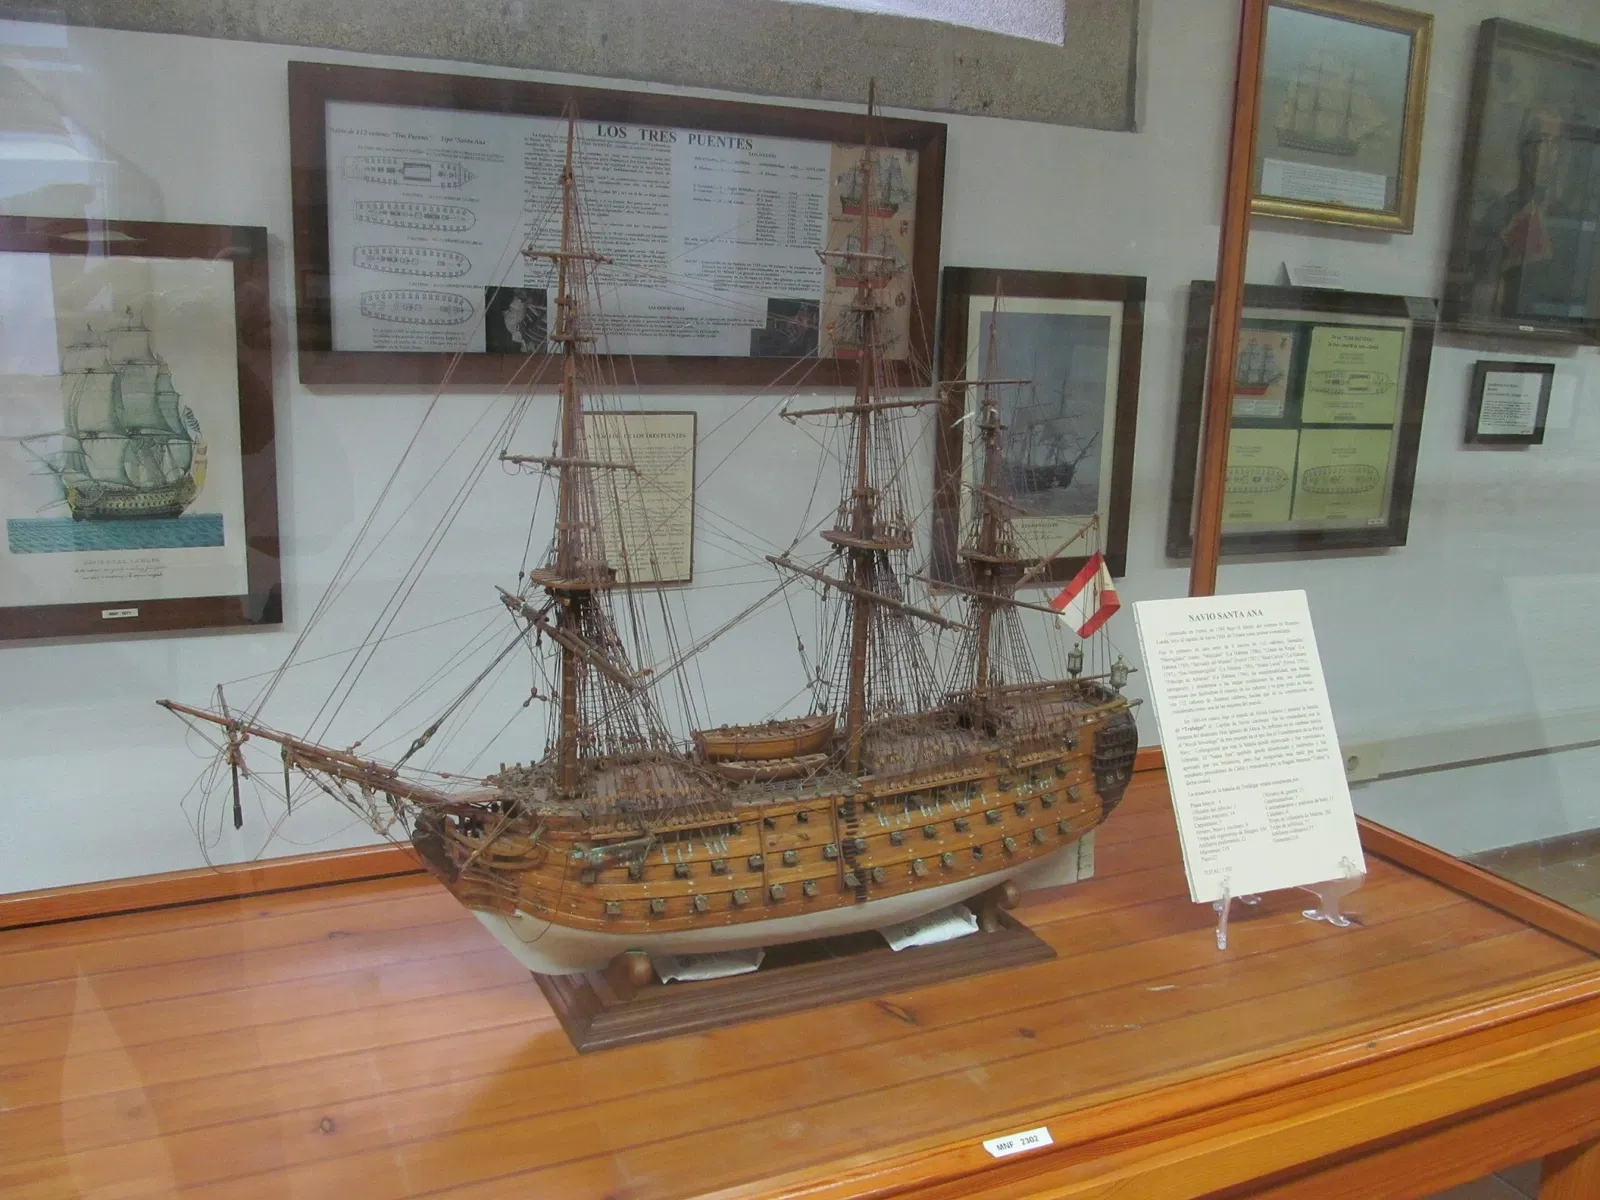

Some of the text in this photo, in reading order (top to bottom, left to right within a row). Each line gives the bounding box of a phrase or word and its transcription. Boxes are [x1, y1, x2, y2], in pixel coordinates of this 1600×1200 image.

[597, 124, 754, 151] LOS TRES PUENTES
[1187, 608, 1263, 621] NAVIO SANTA ANA
[996, 1135, 1039, 1151] MNF 2302
